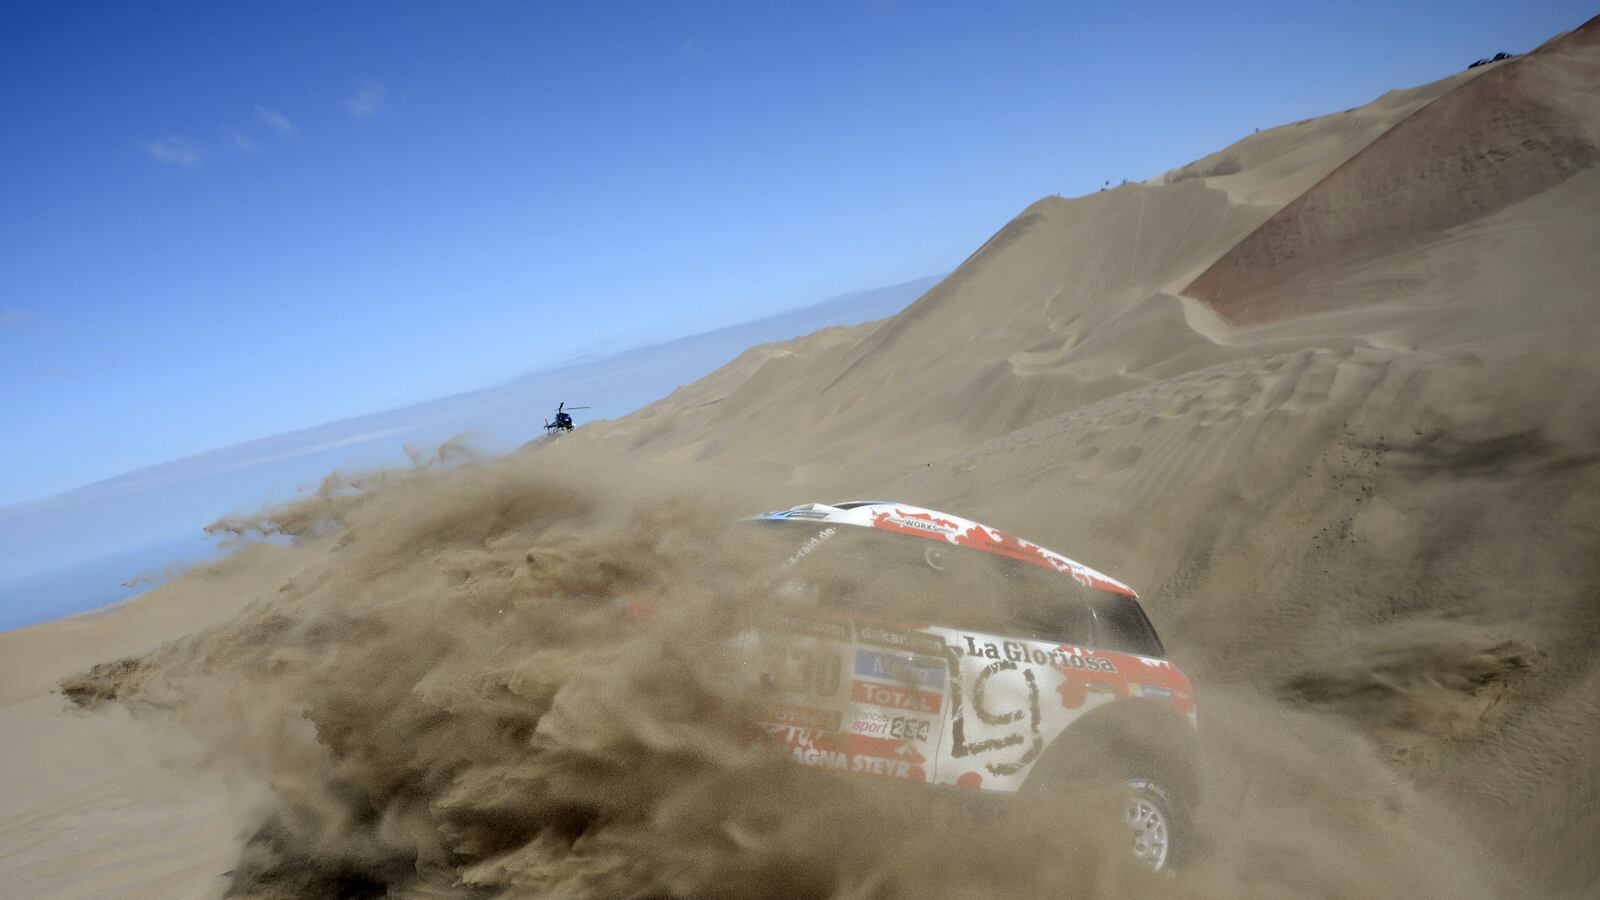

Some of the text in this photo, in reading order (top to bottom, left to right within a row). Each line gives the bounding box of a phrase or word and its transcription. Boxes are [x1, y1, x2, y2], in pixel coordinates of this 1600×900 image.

[905, 519, 939, 532] WORKS
[963, 636, 999, 659] La
[1003, 640, 1118, 673] Gloriosa
[863, 683, 932, 711] TOTAL
[852, 719, 889, 734] sport
[778, 744, 911, 779] AGNA STEYR
